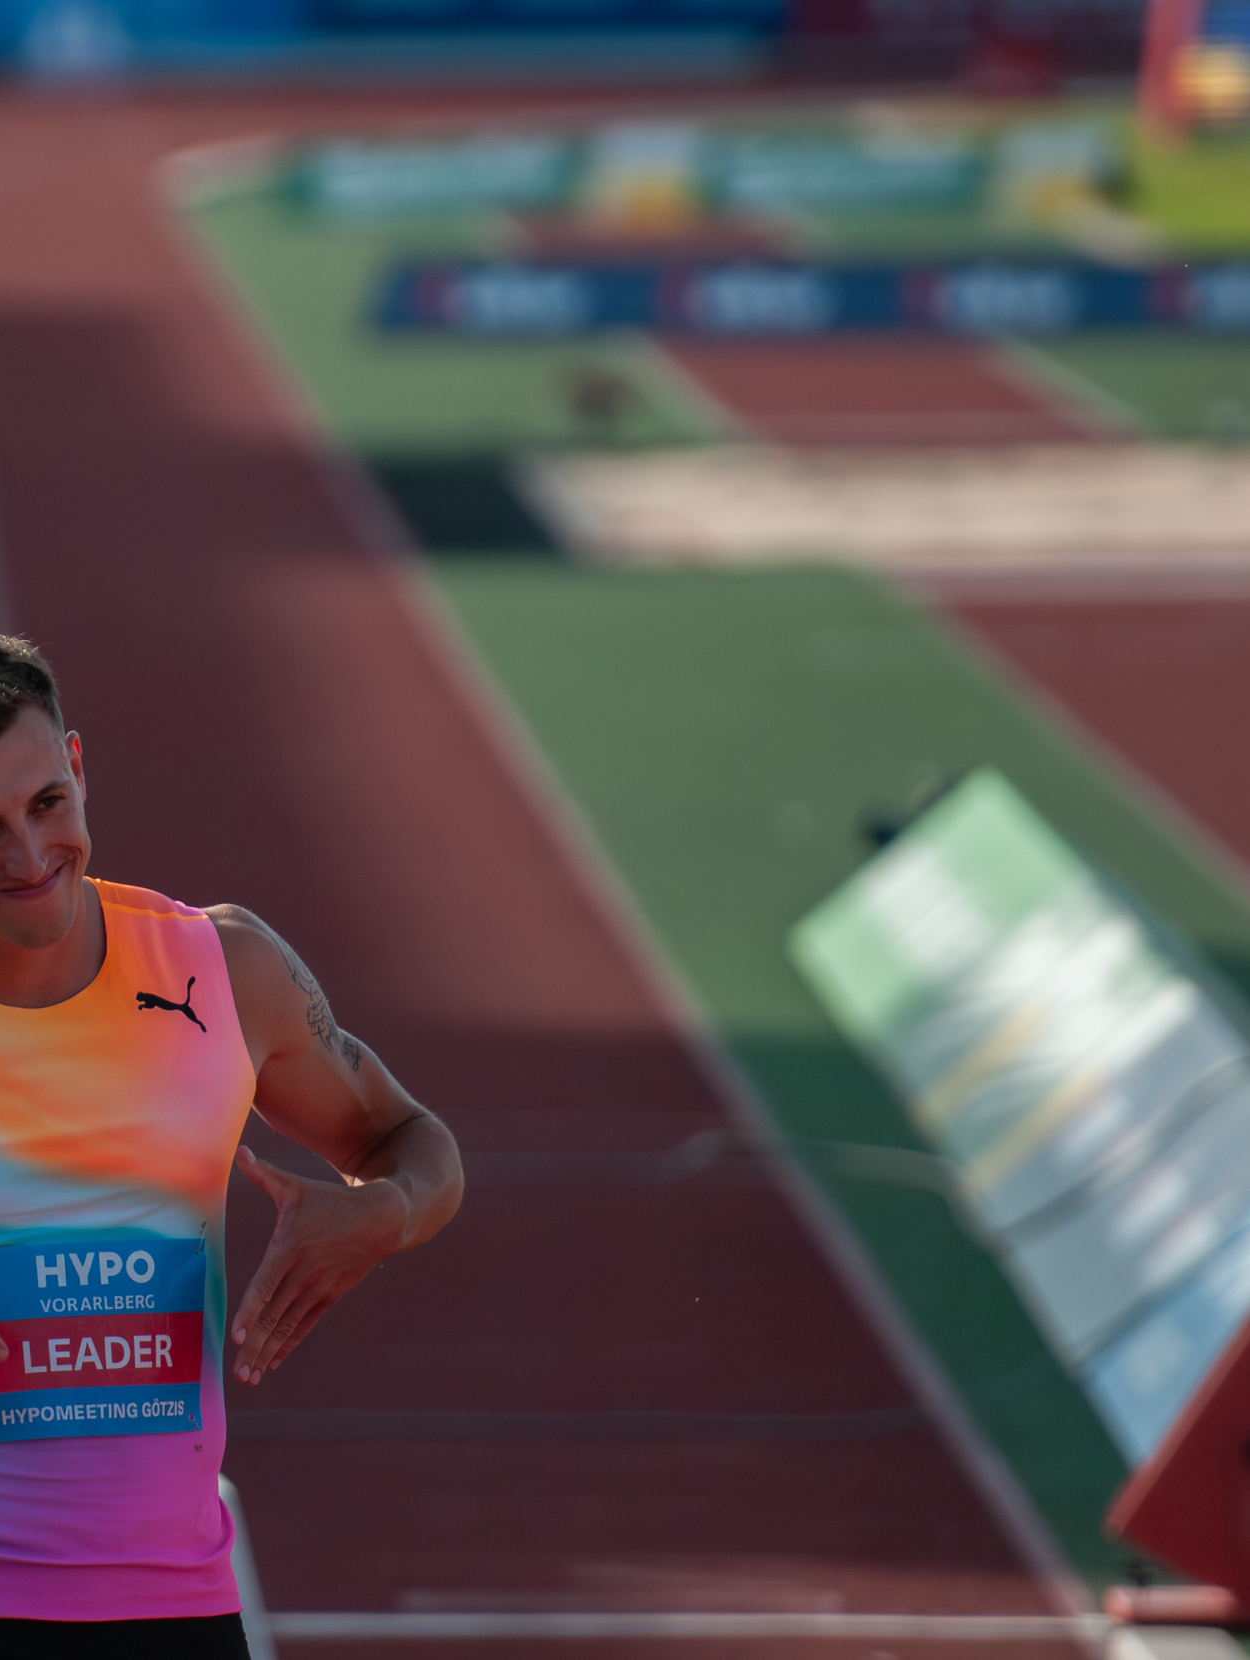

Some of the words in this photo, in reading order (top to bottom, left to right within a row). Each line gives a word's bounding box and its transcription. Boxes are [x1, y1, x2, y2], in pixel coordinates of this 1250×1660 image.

[36, 1250, 155, 1288] HYPO
[40, 1294, 155, 1313] VORARLBERG
[22, 1334, 173, 1374] LEADER
[1, 1403, 139, 1425] HYPOMEETING
[141, 1399, 185, 1417] GÖTZIS
